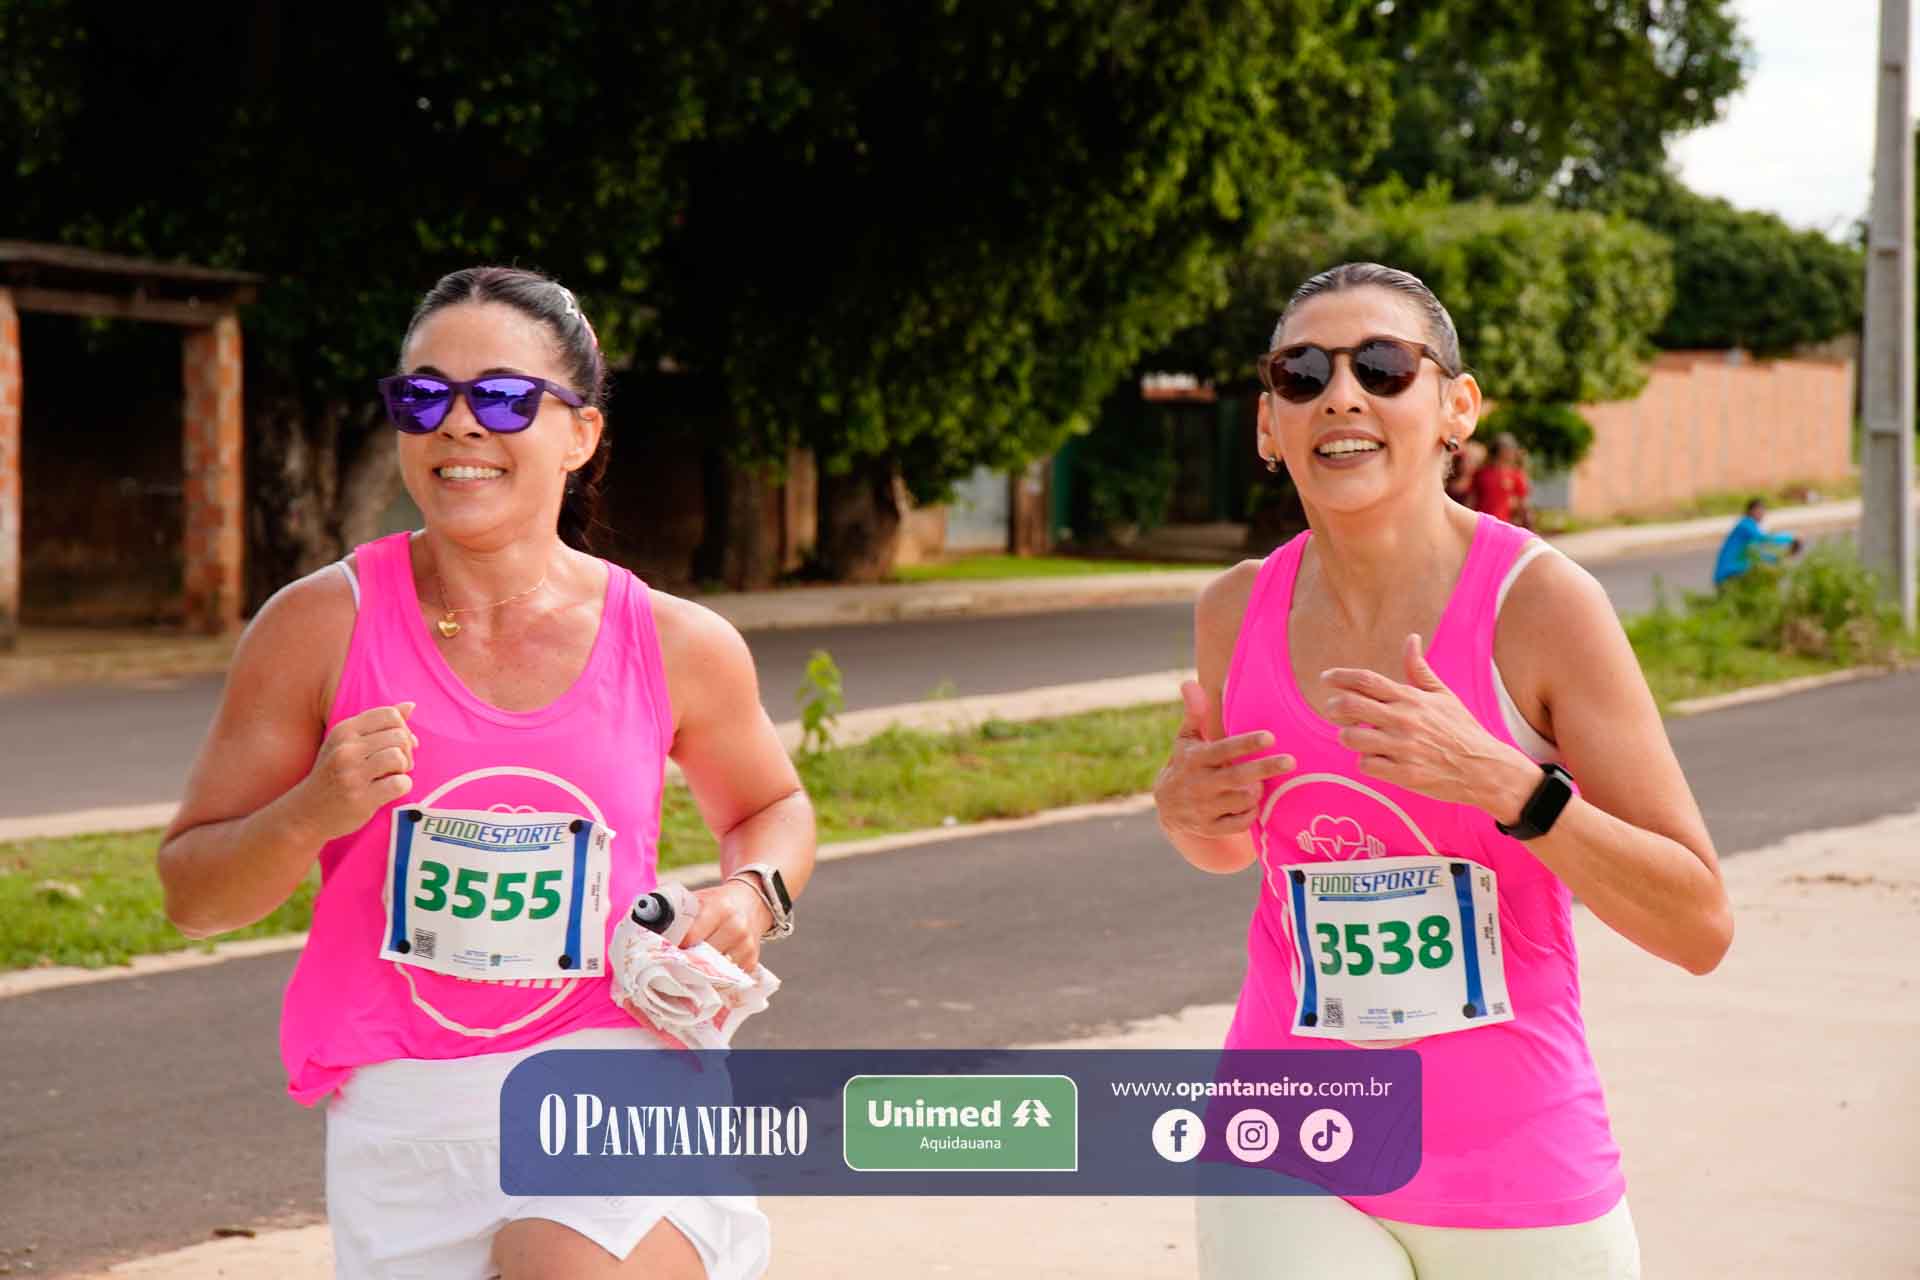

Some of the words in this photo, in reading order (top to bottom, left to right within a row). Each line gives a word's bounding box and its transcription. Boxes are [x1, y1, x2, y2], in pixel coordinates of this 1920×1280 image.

[423, 818, 564, 845] FUNDESPORTE
[414, 860, 563, 921] 3555
[1311, 869, 1441, 893] FUNDESPORTE
[1315, 915, 1454, 976] 3538
